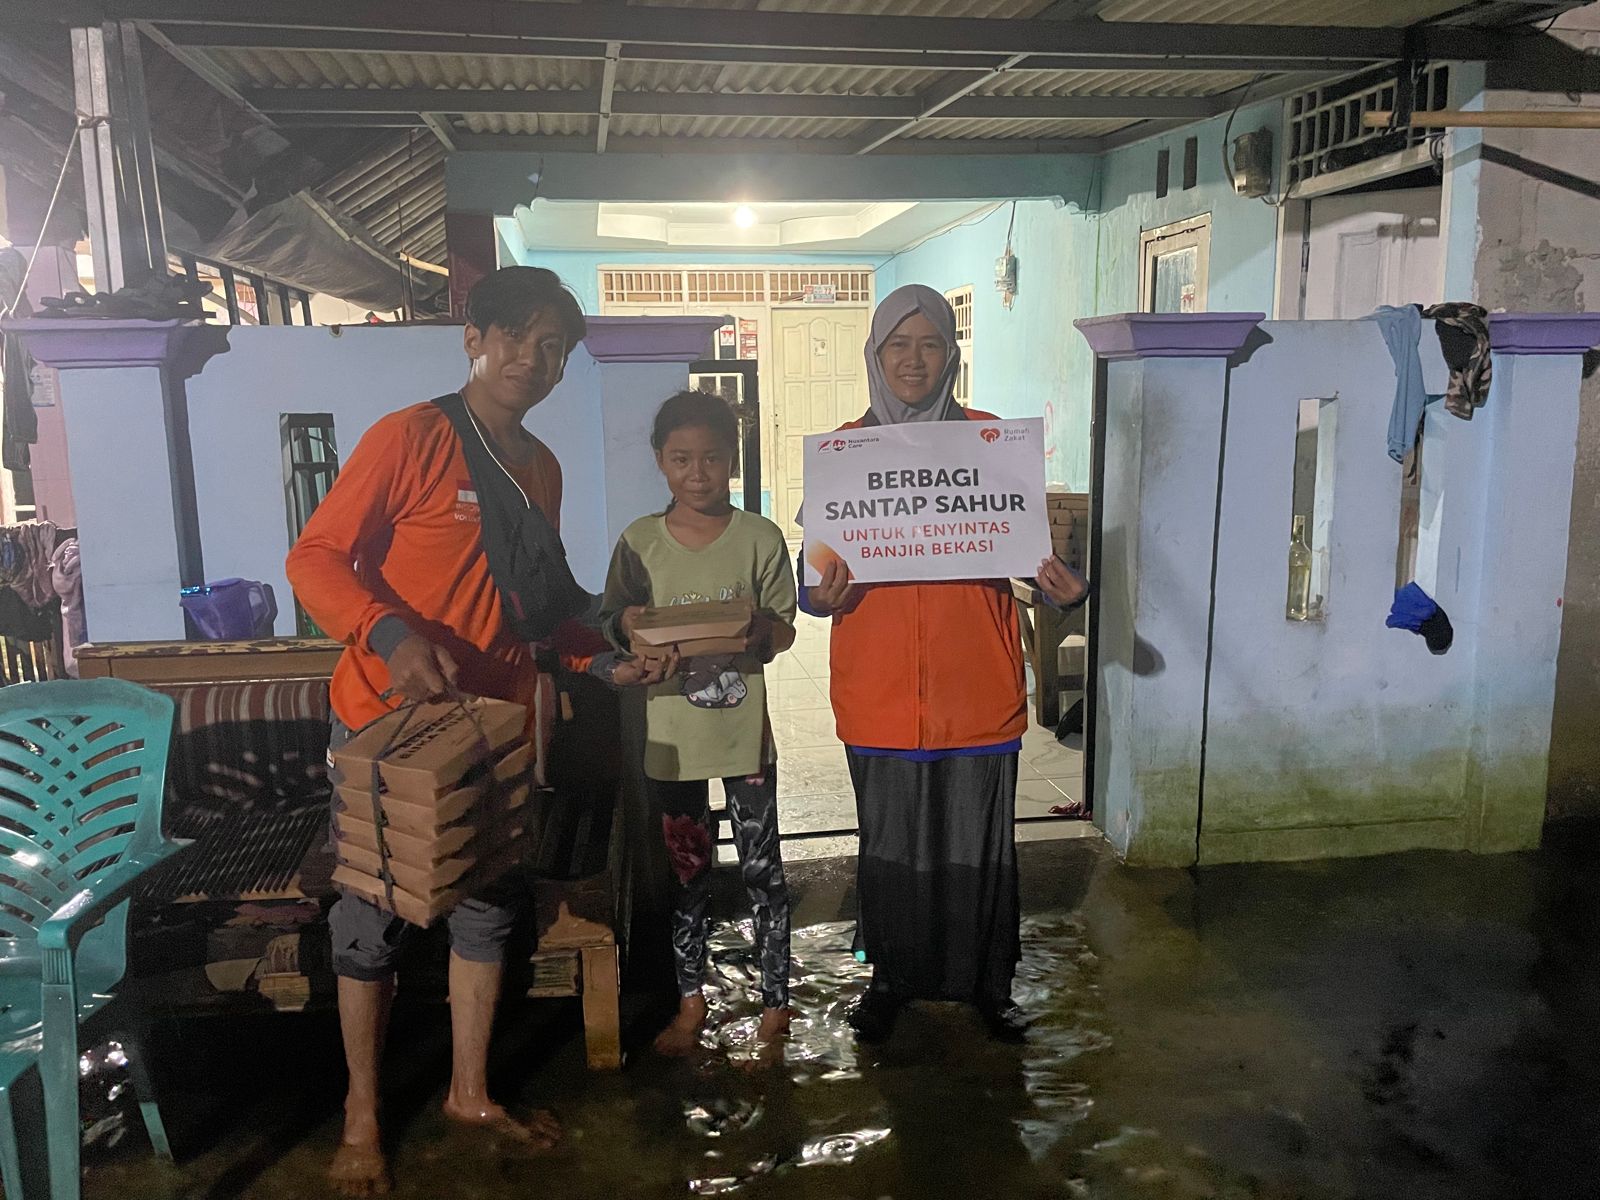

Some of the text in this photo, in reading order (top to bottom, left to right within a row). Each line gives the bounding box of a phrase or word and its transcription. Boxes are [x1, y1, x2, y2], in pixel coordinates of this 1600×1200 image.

[867, 467, 979, 491] BERBAGI
[825, 493, 1026, 521] SANTAP SAHUR
[843, 520, 1011, 542] UNTUK PENYINTAS
[861, 539, 994, 559] BANJIR BEKASI
